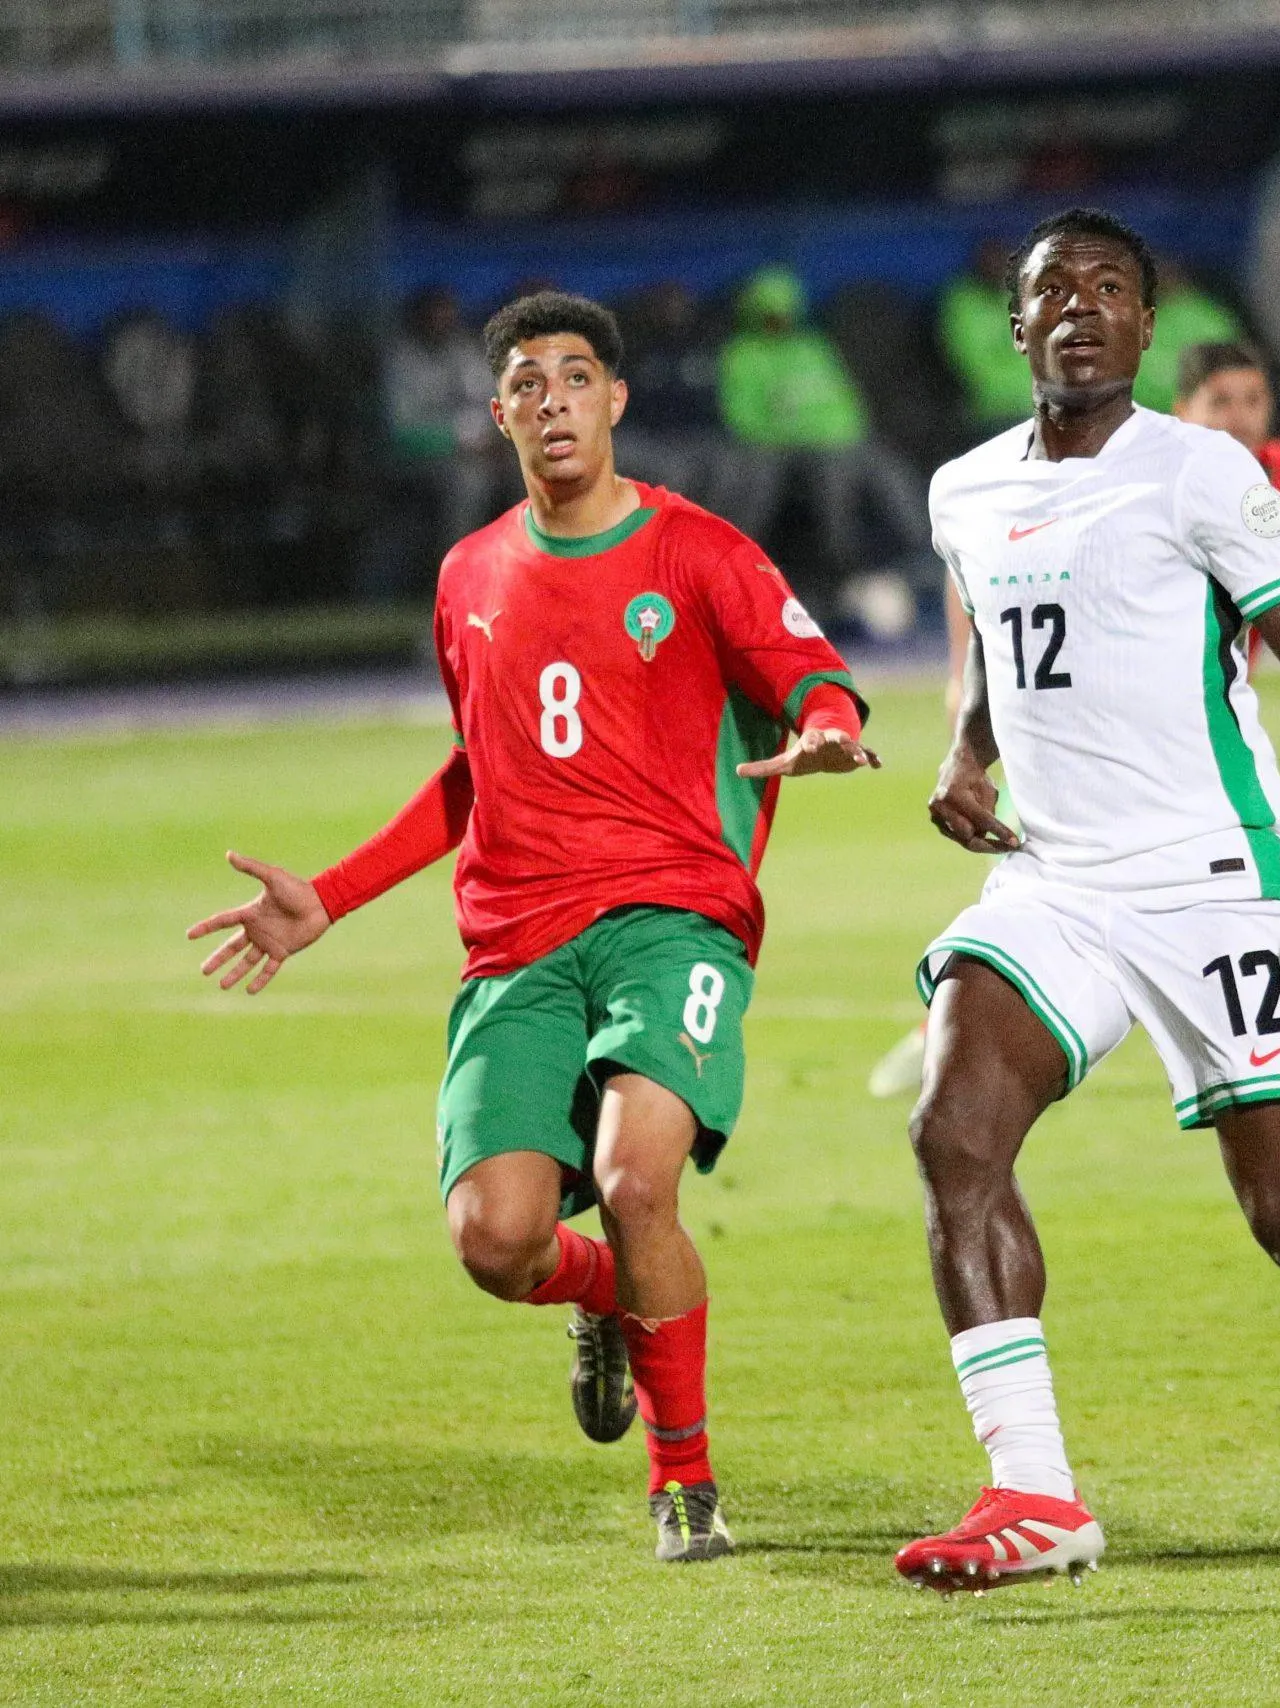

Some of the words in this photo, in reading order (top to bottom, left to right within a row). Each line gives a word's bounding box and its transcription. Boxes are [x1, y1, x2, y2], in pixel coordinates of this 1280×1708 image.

[1000, 603, 1072, 690] 12
[539, 661, 583, 758] 8
[683, 962, 725, 1043] 8
